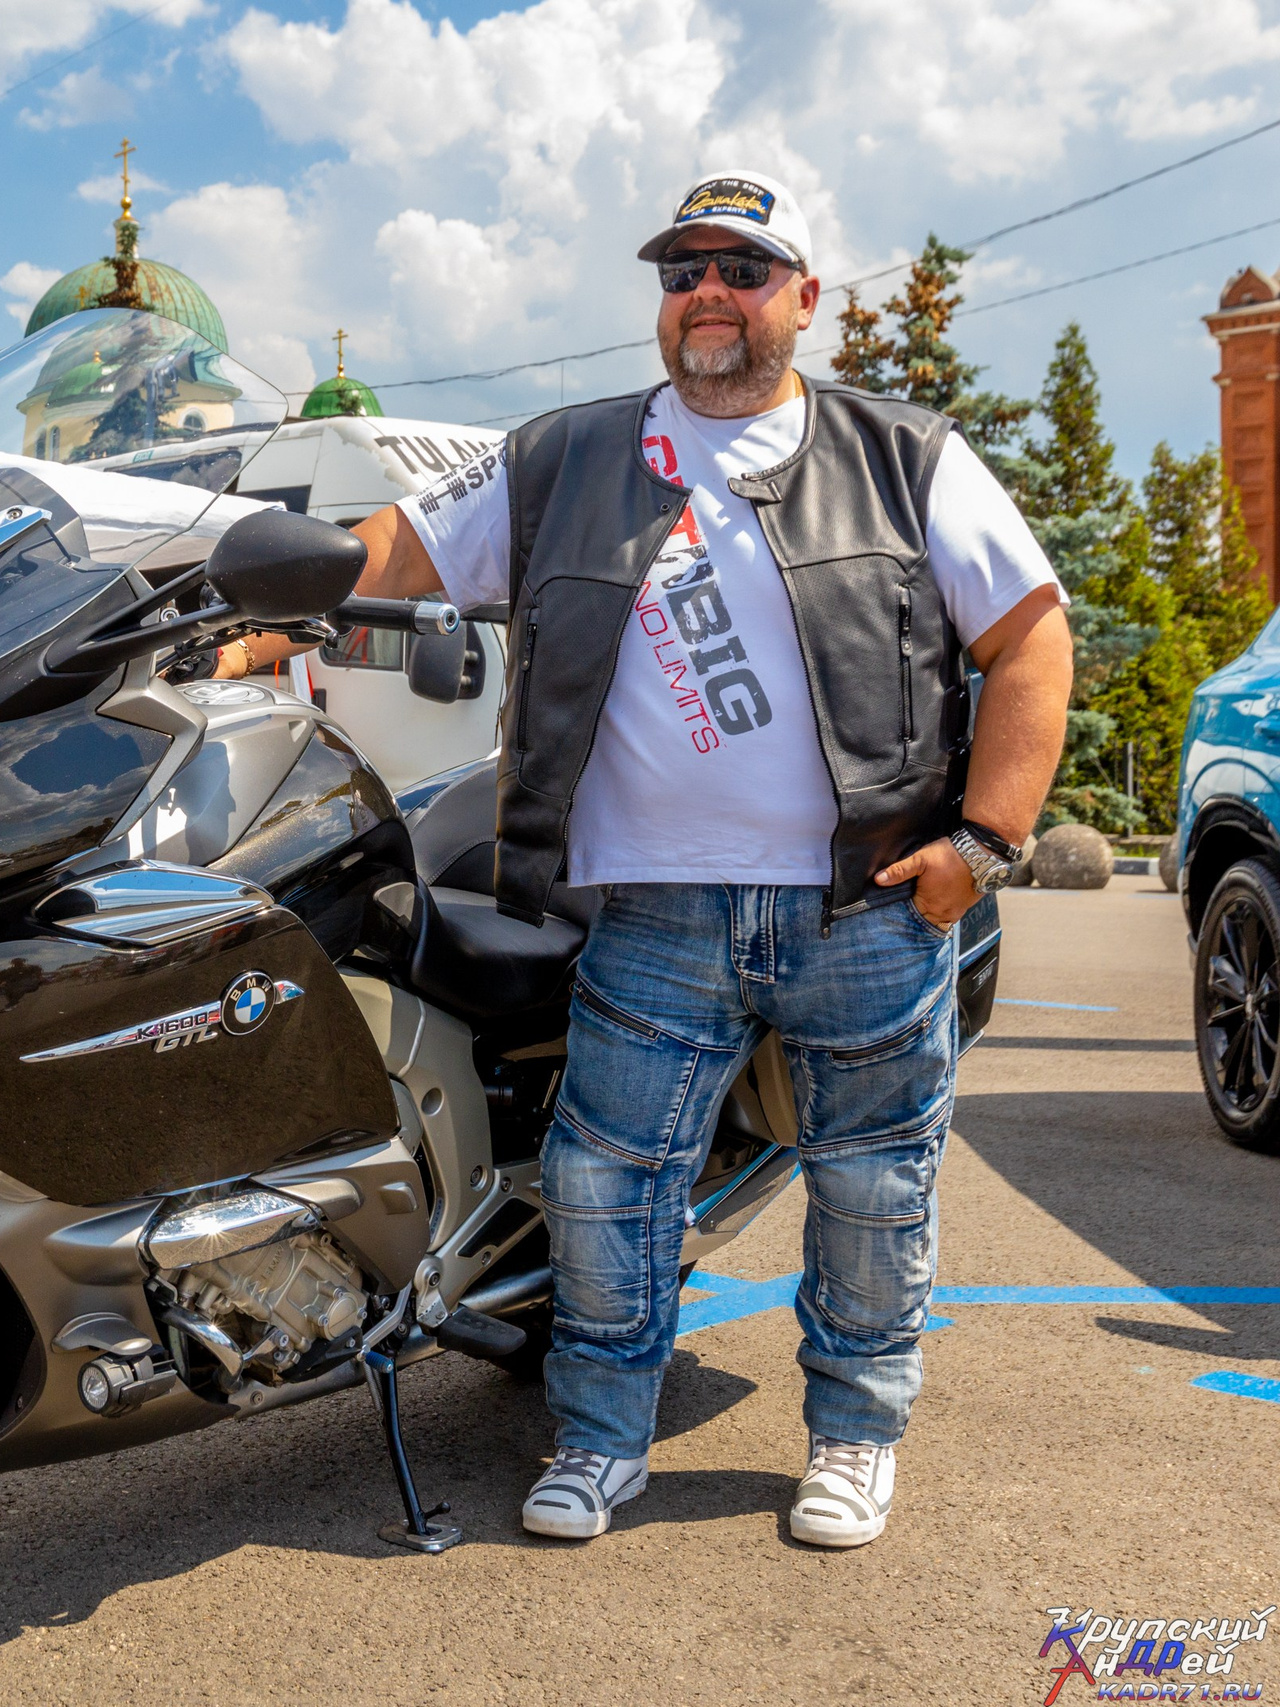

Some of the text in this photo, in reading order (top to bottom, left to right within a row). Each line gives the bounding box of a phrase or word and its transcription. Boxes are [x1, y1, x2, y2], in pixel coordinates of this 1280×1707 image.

[742, 182, 764, 196] BEST
[691, 206, 747, 217] FOR EXPERTS
[635, 580, 720, 754] NO LIMITS
[665, 580, 772, 736] BIG
[230, 977, 272, 1002] BMW
[154, 1028, 218, 1053] GTL
